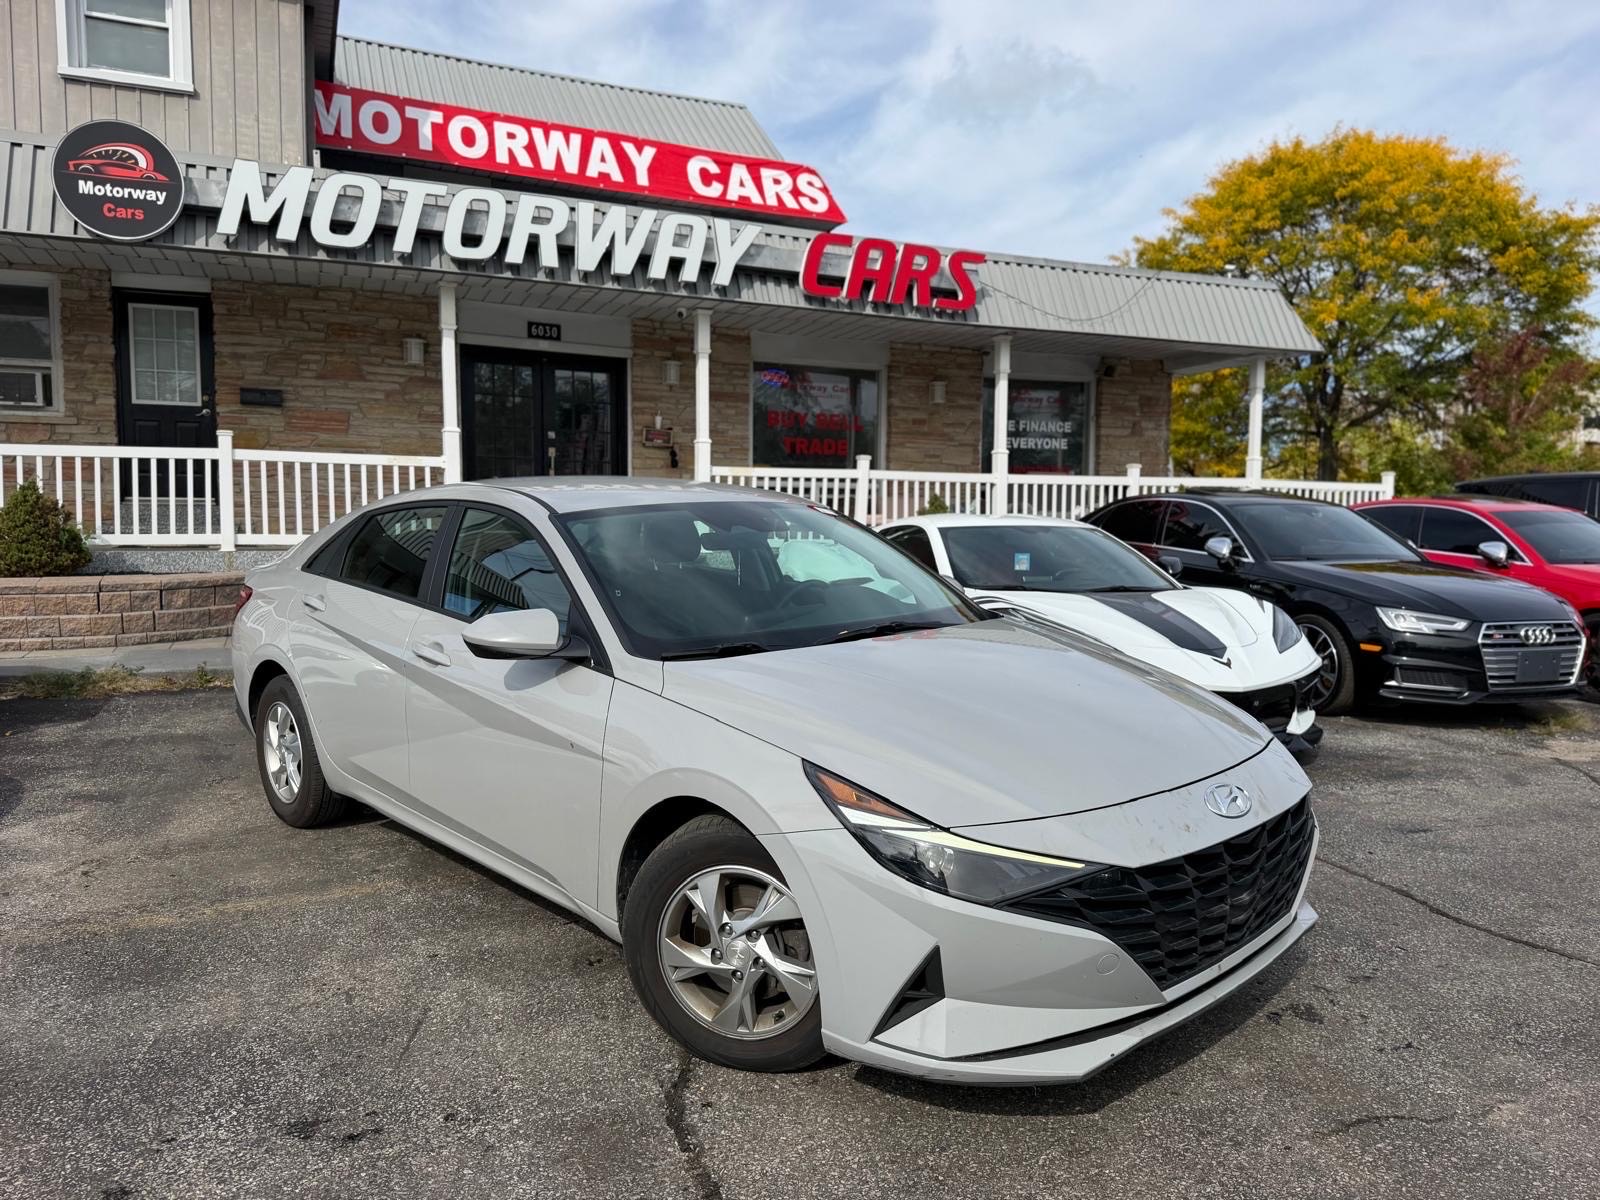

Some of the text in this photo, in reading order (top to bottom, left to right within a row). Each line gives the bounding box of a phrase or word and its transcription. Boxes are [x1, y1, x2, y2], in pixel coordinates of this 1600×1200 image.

[314, 89, 829, 213] MOTORWAY CARS
[78, 180, 166, 205] Motorway
[103, 203, 144, 220] Cars
[215, 158, 986, 311] MOTORWAY CARS
[531, 324, 558, 338] 6030
[767, 410, 808, 428] BUY
[1019, 420, 1072, 433] FINANCE
[783, 437, 848, 457] TRADE
[1006, 437, 1068, 449] EVERYONE
